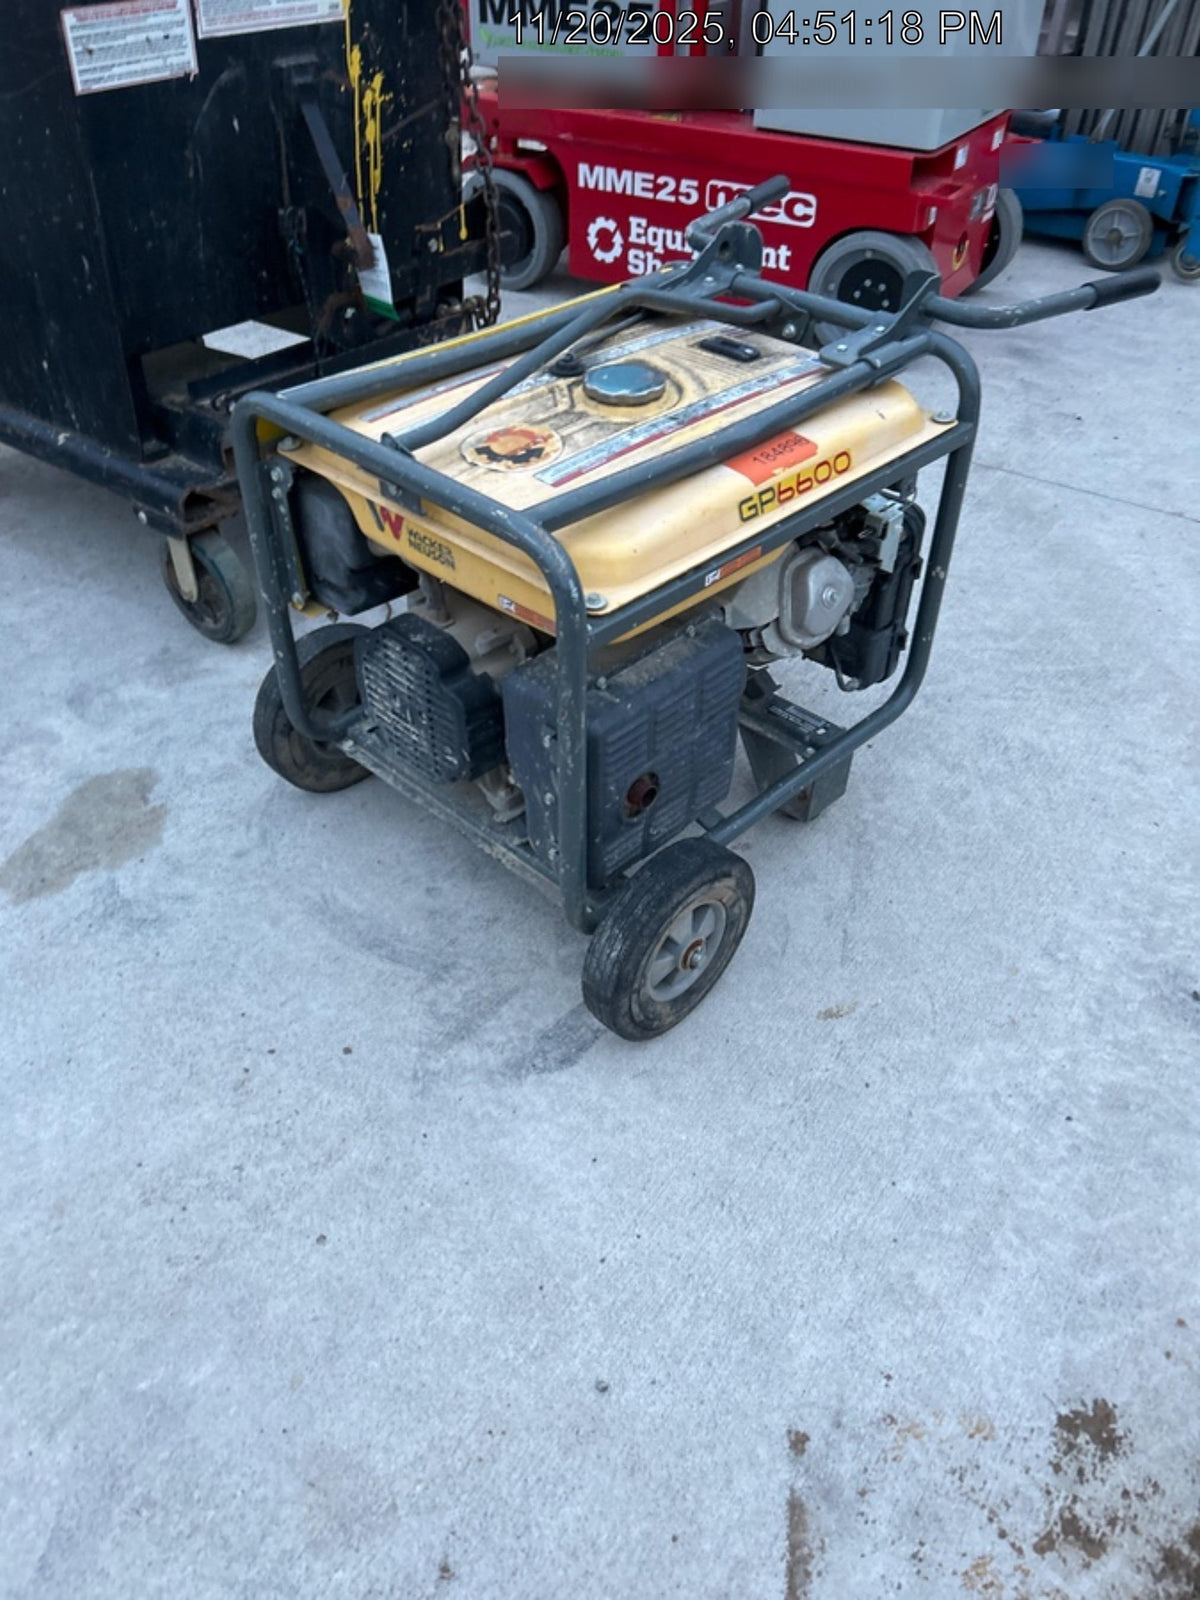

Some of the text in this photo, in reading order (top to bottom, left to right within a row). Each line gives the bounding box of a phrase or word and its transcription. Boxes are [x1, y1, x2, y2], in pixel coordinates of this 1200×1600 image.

[479, 0, 654, 39] MME25
[577, 162, 699, 206] MME25
[738, 450, 852, 523] GP6600
